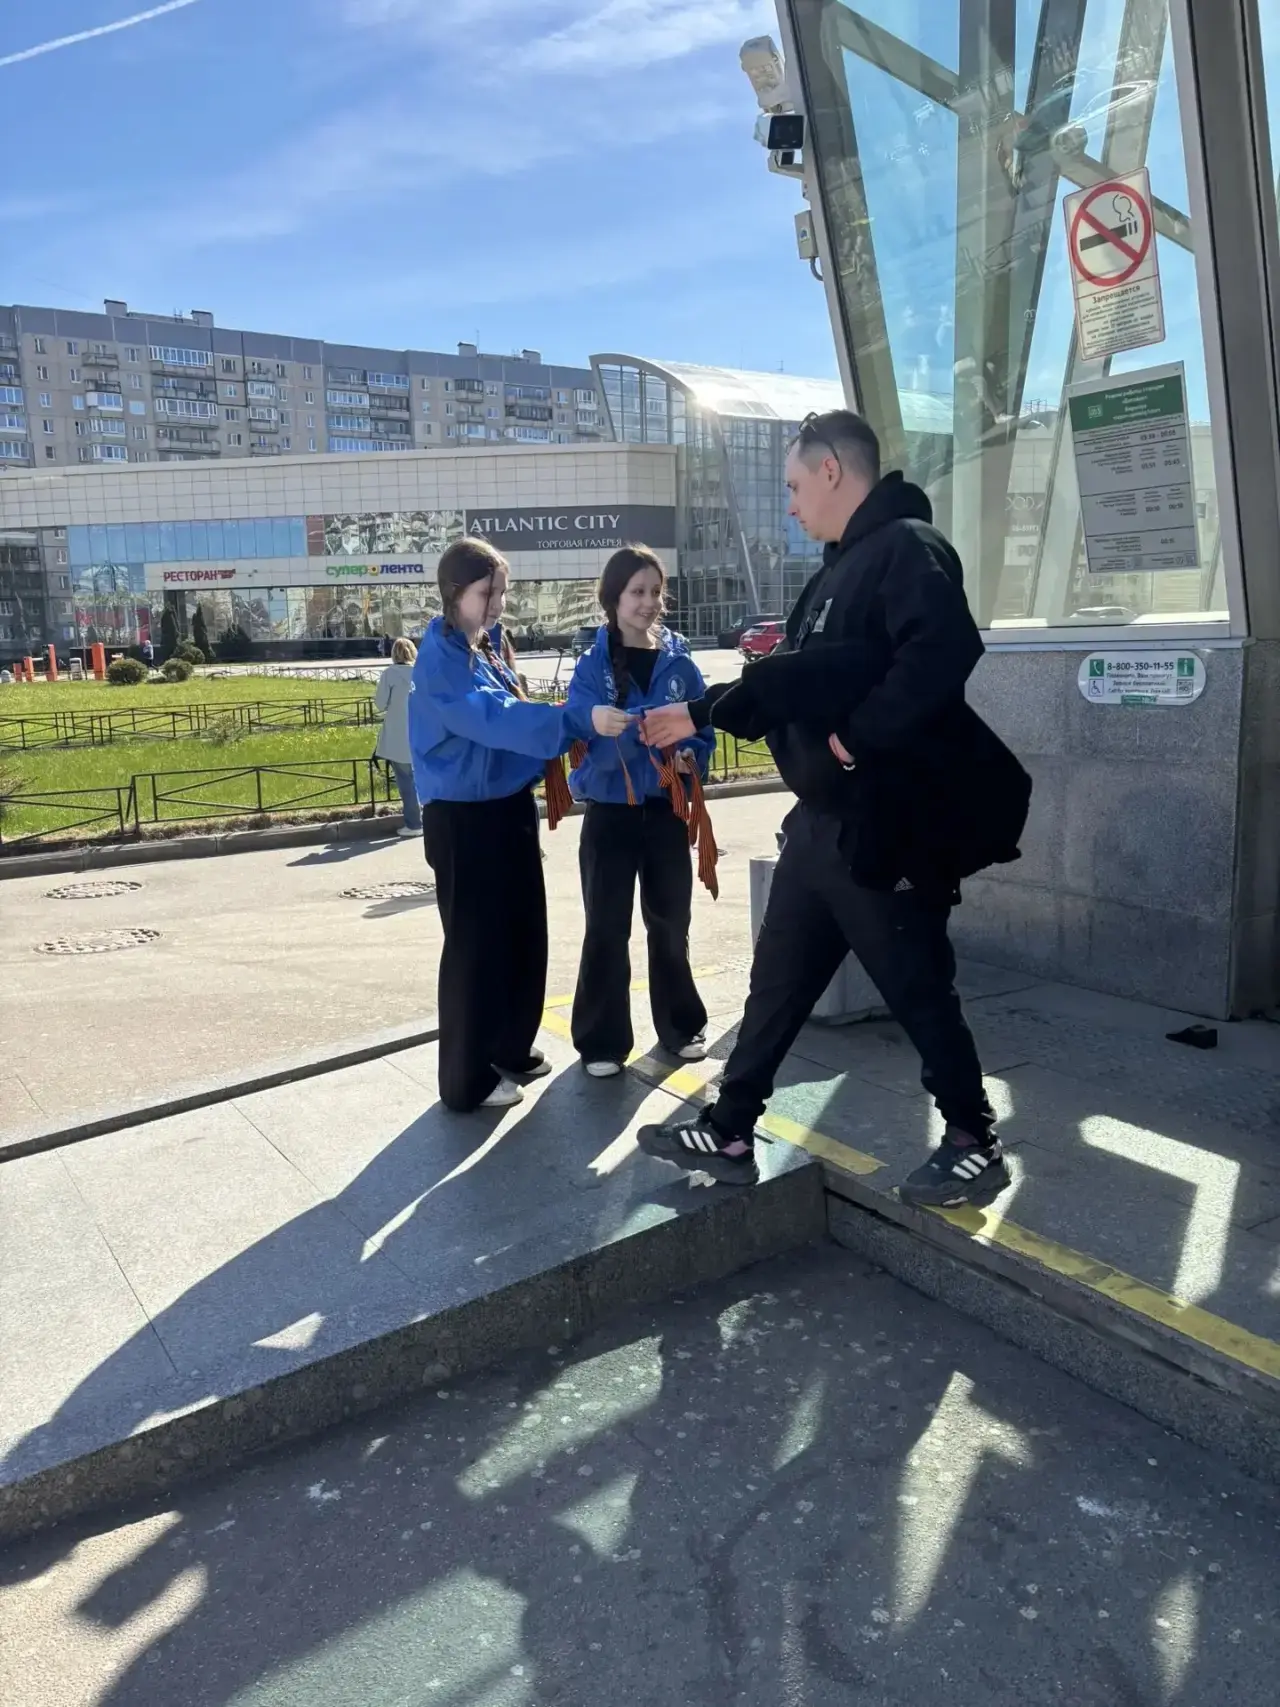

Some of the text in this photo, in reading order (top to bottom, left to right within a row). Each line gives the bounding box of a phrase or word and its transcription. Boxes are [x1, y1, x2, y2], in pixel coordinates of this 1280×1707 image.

[1092, 285, 1141, 304] Запрещается
[470, 514, 620, 533] ATLANTIC CITY
[538, 538, 622, 549] ТОРГОВАЯ ГАЛЕРЕЯ
[379, 563, 425, 574] лента
[163, 570, 217, 582] РЕСТОРАН
[1107, 661, 1174, 671] 8-800-350-11-55
